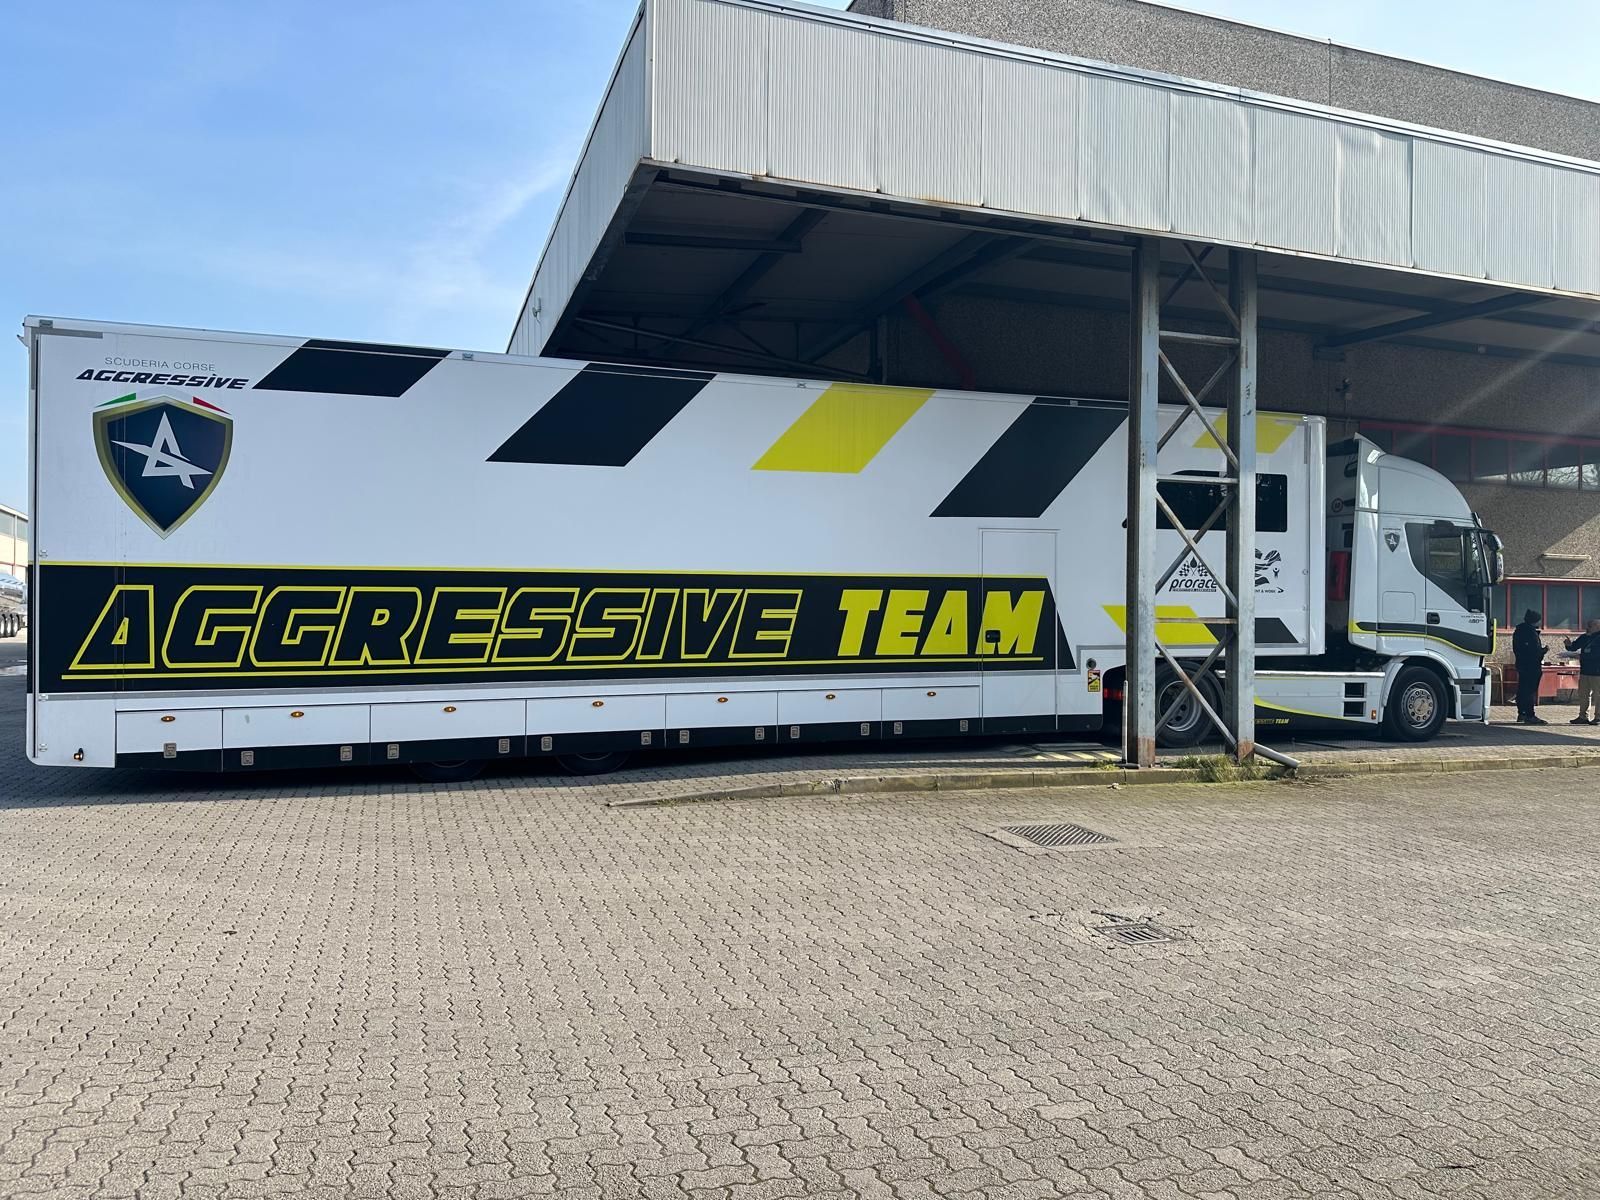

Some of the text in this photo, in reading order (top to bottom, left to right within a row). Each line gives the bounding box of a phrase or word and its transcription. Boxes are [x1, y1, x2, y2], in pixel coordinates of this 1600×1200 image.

[105, 357, 215, 371] SCUDERIA CORSE
[68, 585, 1046, 670] AGGRESSIVE TEAM
